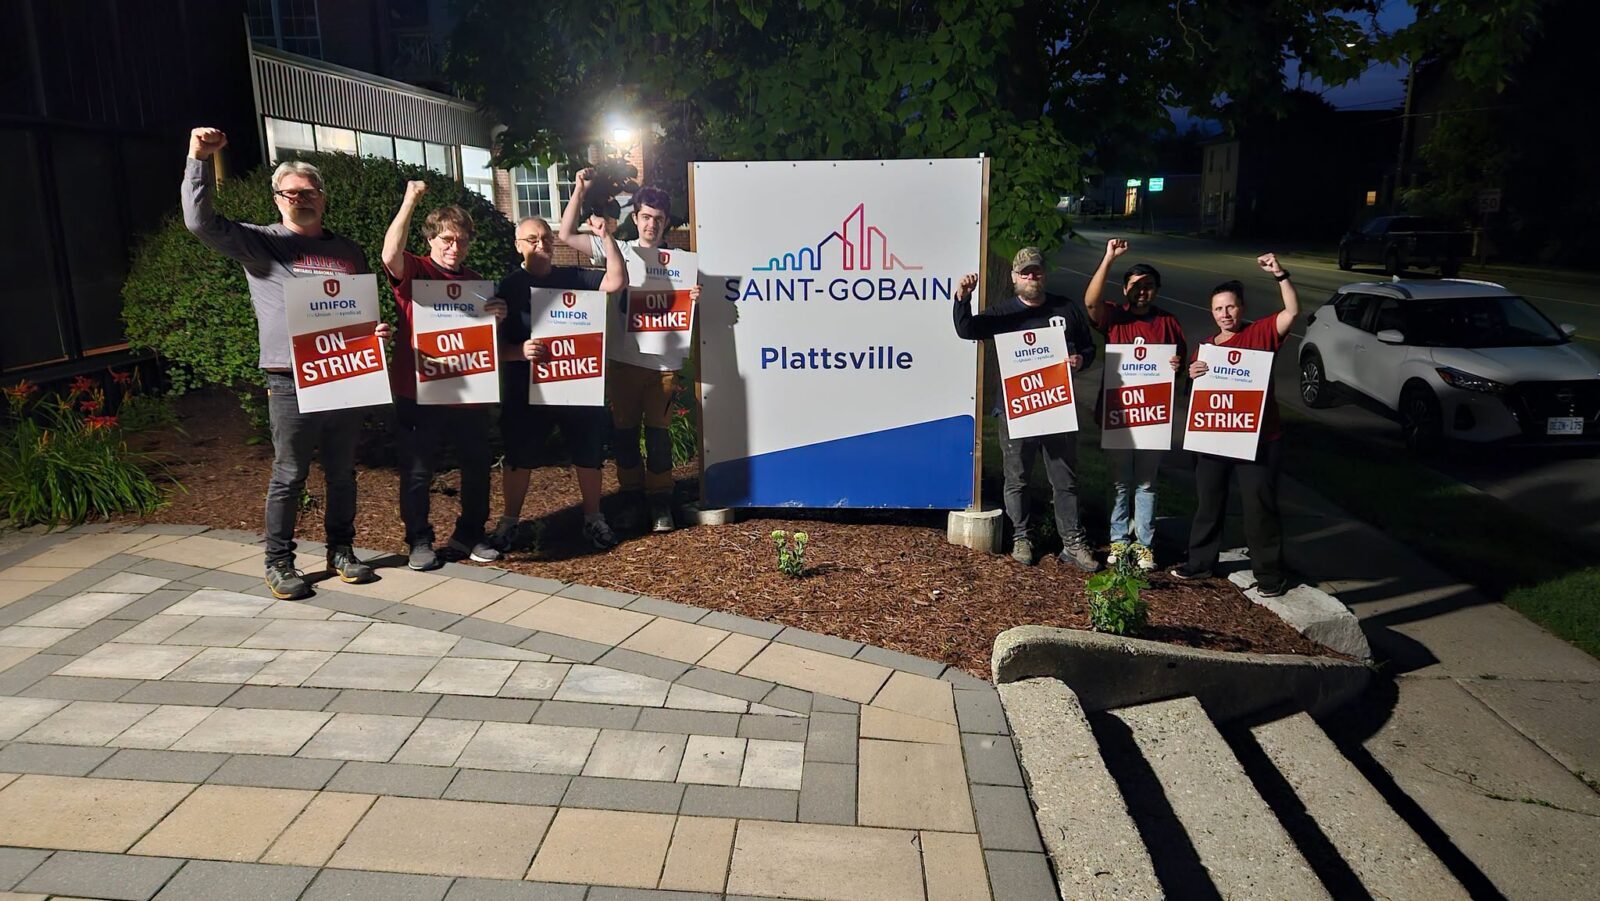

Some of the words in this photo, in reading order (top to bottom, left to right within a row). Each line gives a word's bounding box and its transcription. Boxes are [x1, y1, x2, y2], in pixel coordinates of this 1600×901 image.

[646, 266, 680, 278] UNIFOR
[724, 277, 952, 302] SAINT-GOBAIN
[310, 299, 357, 311] UNIFOR
[433, 303, 474, 312] UNIFOR
[645, 293, 668, 309] ON
[549, 309, 588, 320] UNIFOR
[633, 311, 687, 329] STRIKE
[315, 331, 347, 354] ON
[436, 332, 464, 353] ON
[551, 338, 576, 357] ON
[760, 346, 914, 370] Plattsville
[1015, 346, 1050, 358] UNIFOR
[301, 348, 379, 382] STRIKE
[422, 350, 491, 377] STRIKE
[537, 357, 599, 379] STRIKE
[1122, 363, 1157, 371] UNIFOR
[1213, 366, 1250, 377] UNIFOR
[1020, 373, 1044, 392] ON
[1011, 385, 1068, 414] STRIKE
[1121, 389, 1145, 405] ON
[1209, 393, 1233, 410] ON
[1109, 404, 1166, 426] STRIKE
[1194, 412, 1254, 429] STRIKE
